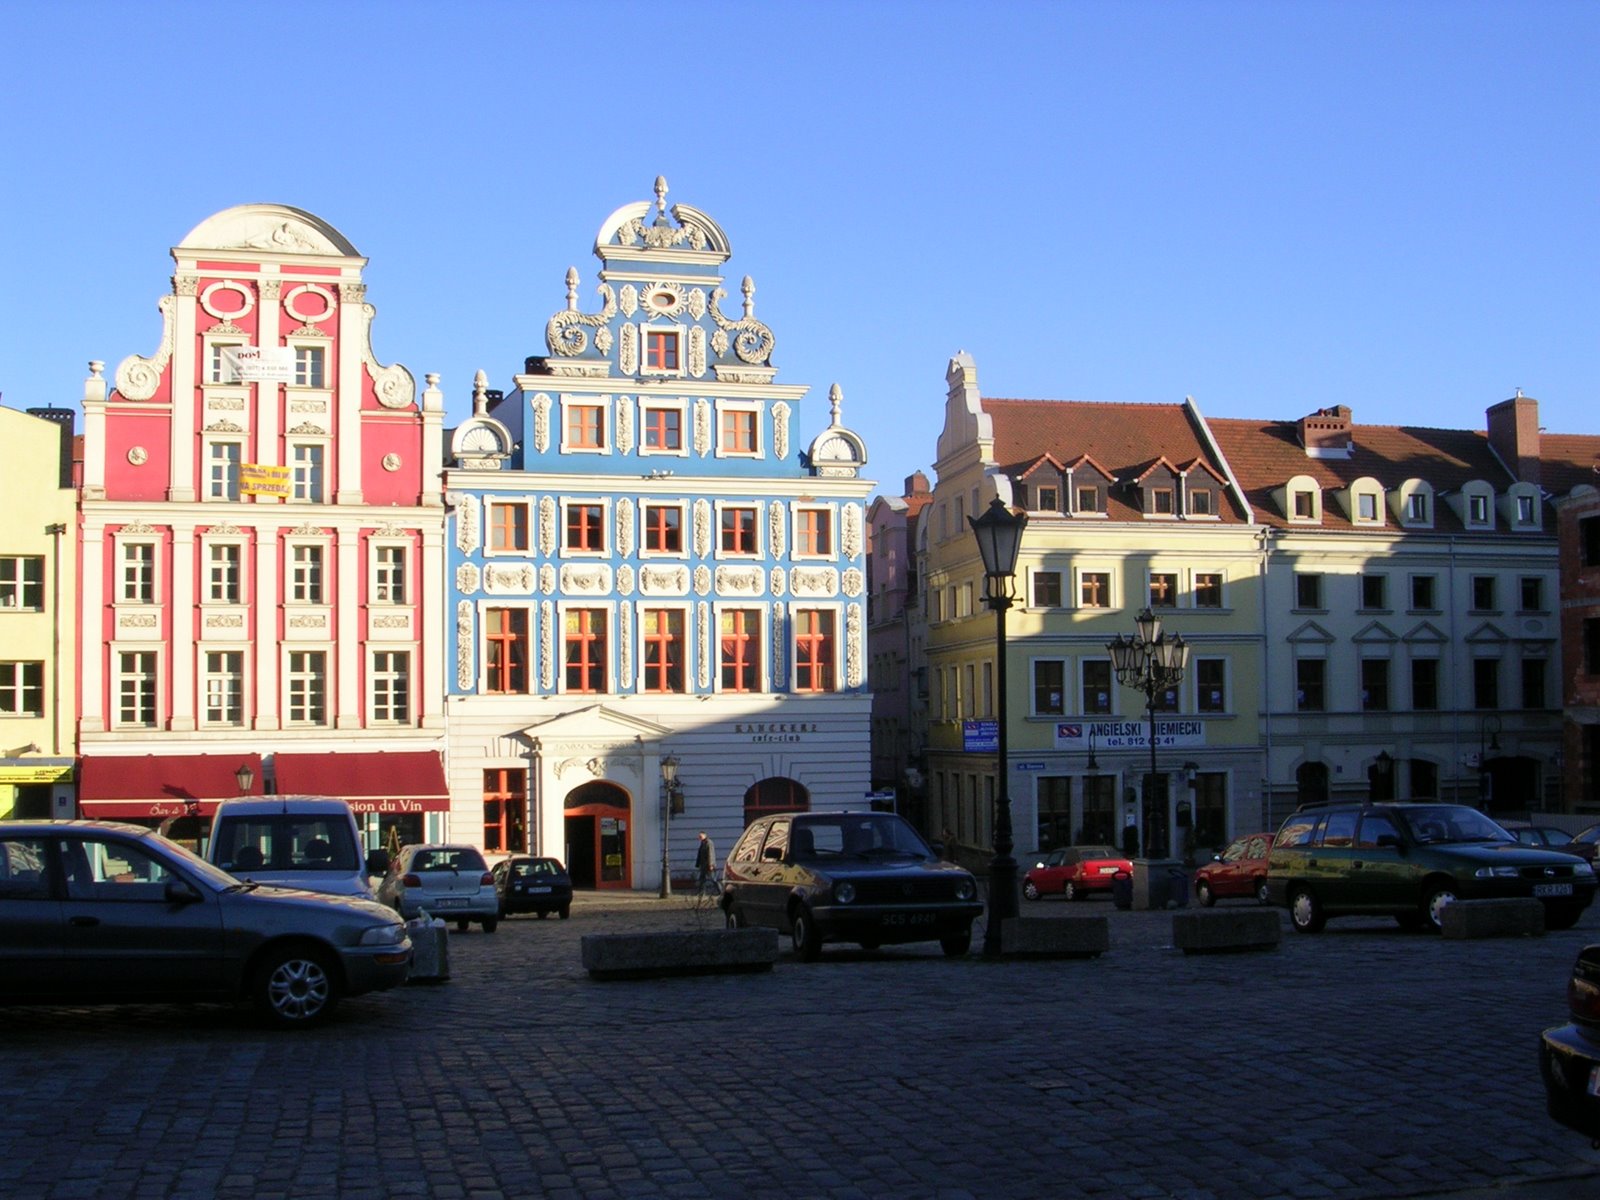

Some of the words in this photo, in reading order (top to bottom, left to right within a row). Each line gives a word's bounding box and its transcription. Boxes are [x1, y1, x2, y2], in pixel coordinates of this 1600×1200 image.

[1090, 723, 1141, 736] ANGIELSKI
[1108, 738, 1125, 746] tel.
[1128, 737, 1144, 745] 812
[380, 800, 396, 811] du
[400, 800, 422, 811] Vin
